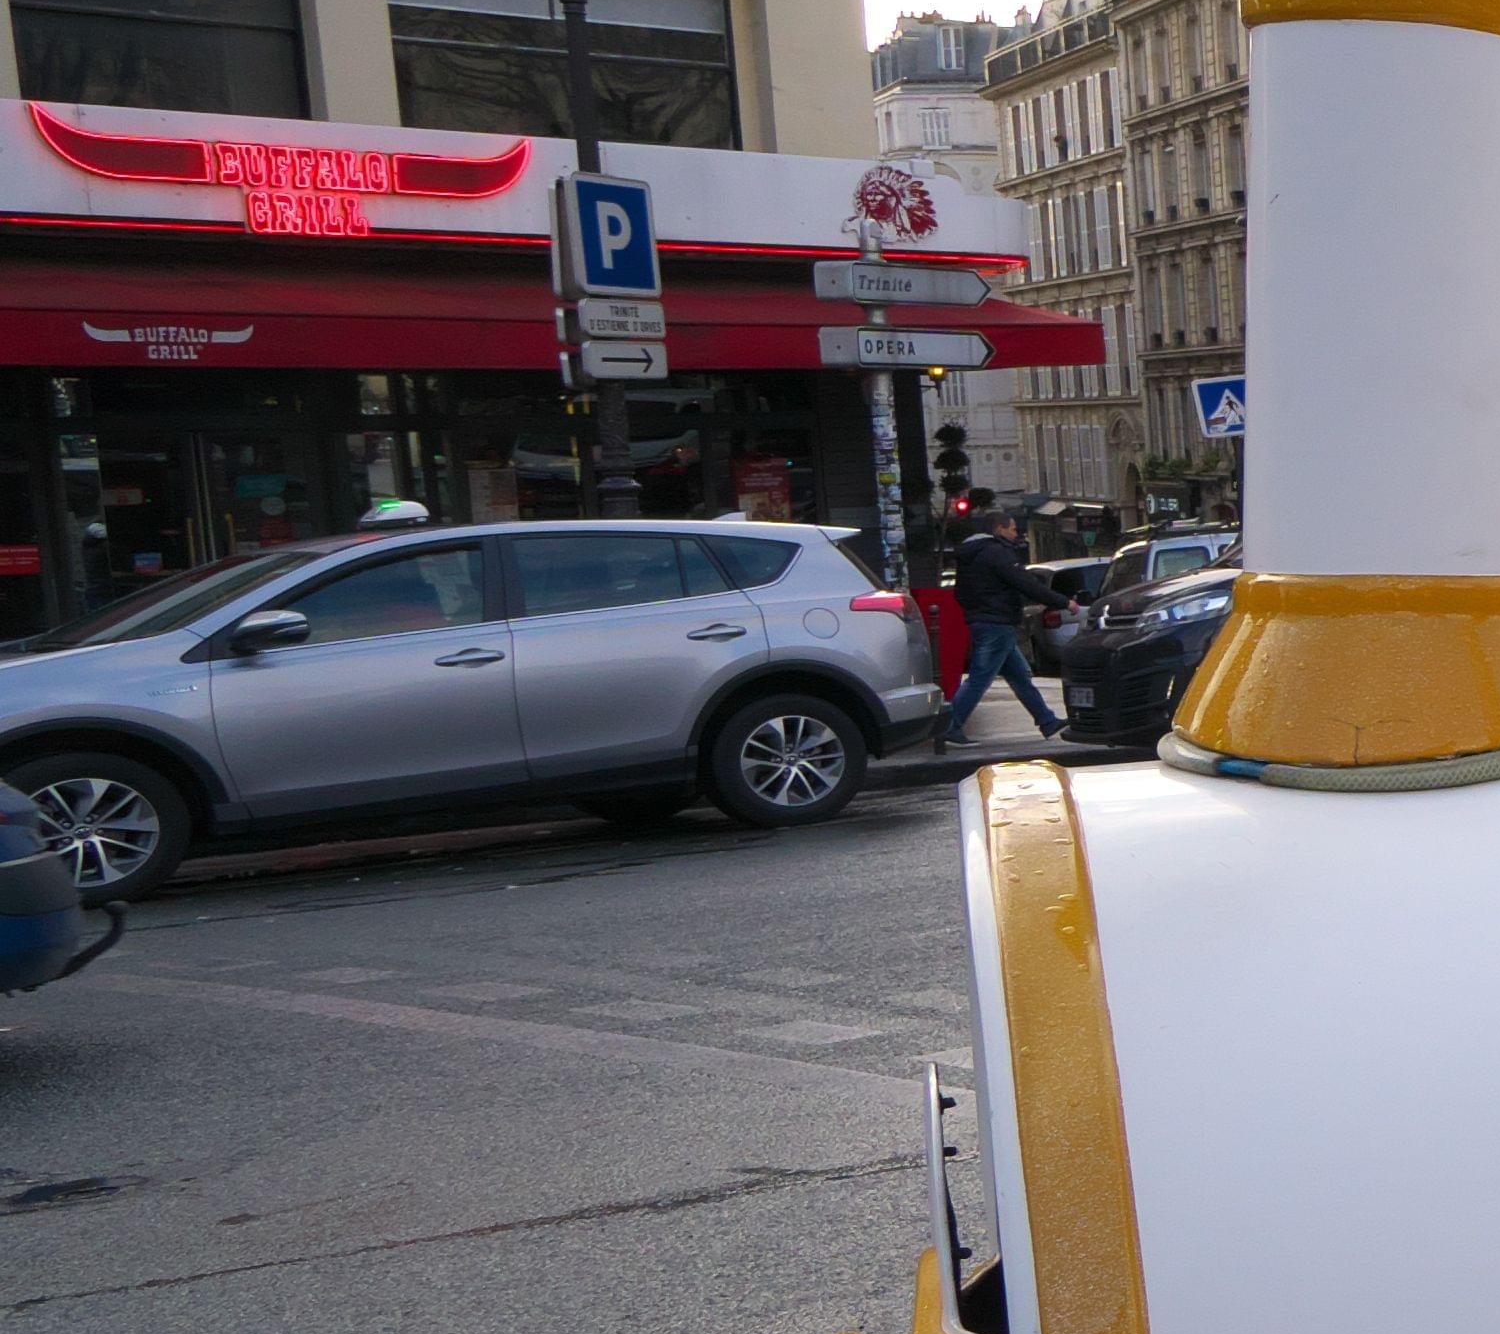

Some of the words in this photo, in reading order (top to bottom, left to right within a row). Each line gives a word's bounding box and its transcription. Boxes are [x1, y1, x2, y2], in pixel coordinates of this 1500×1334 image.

[215, 142, 390, 193] BUFFALO
[247, 190, 369, 238] GRILL
[596, 200, 633, 270] P
[859, 273, 913, 293] Trinité
[133, 326, 209, 344] BUFFALO
[147, 345, 199, 360] GRILL
[864, 338, 917, 357] OPERA
